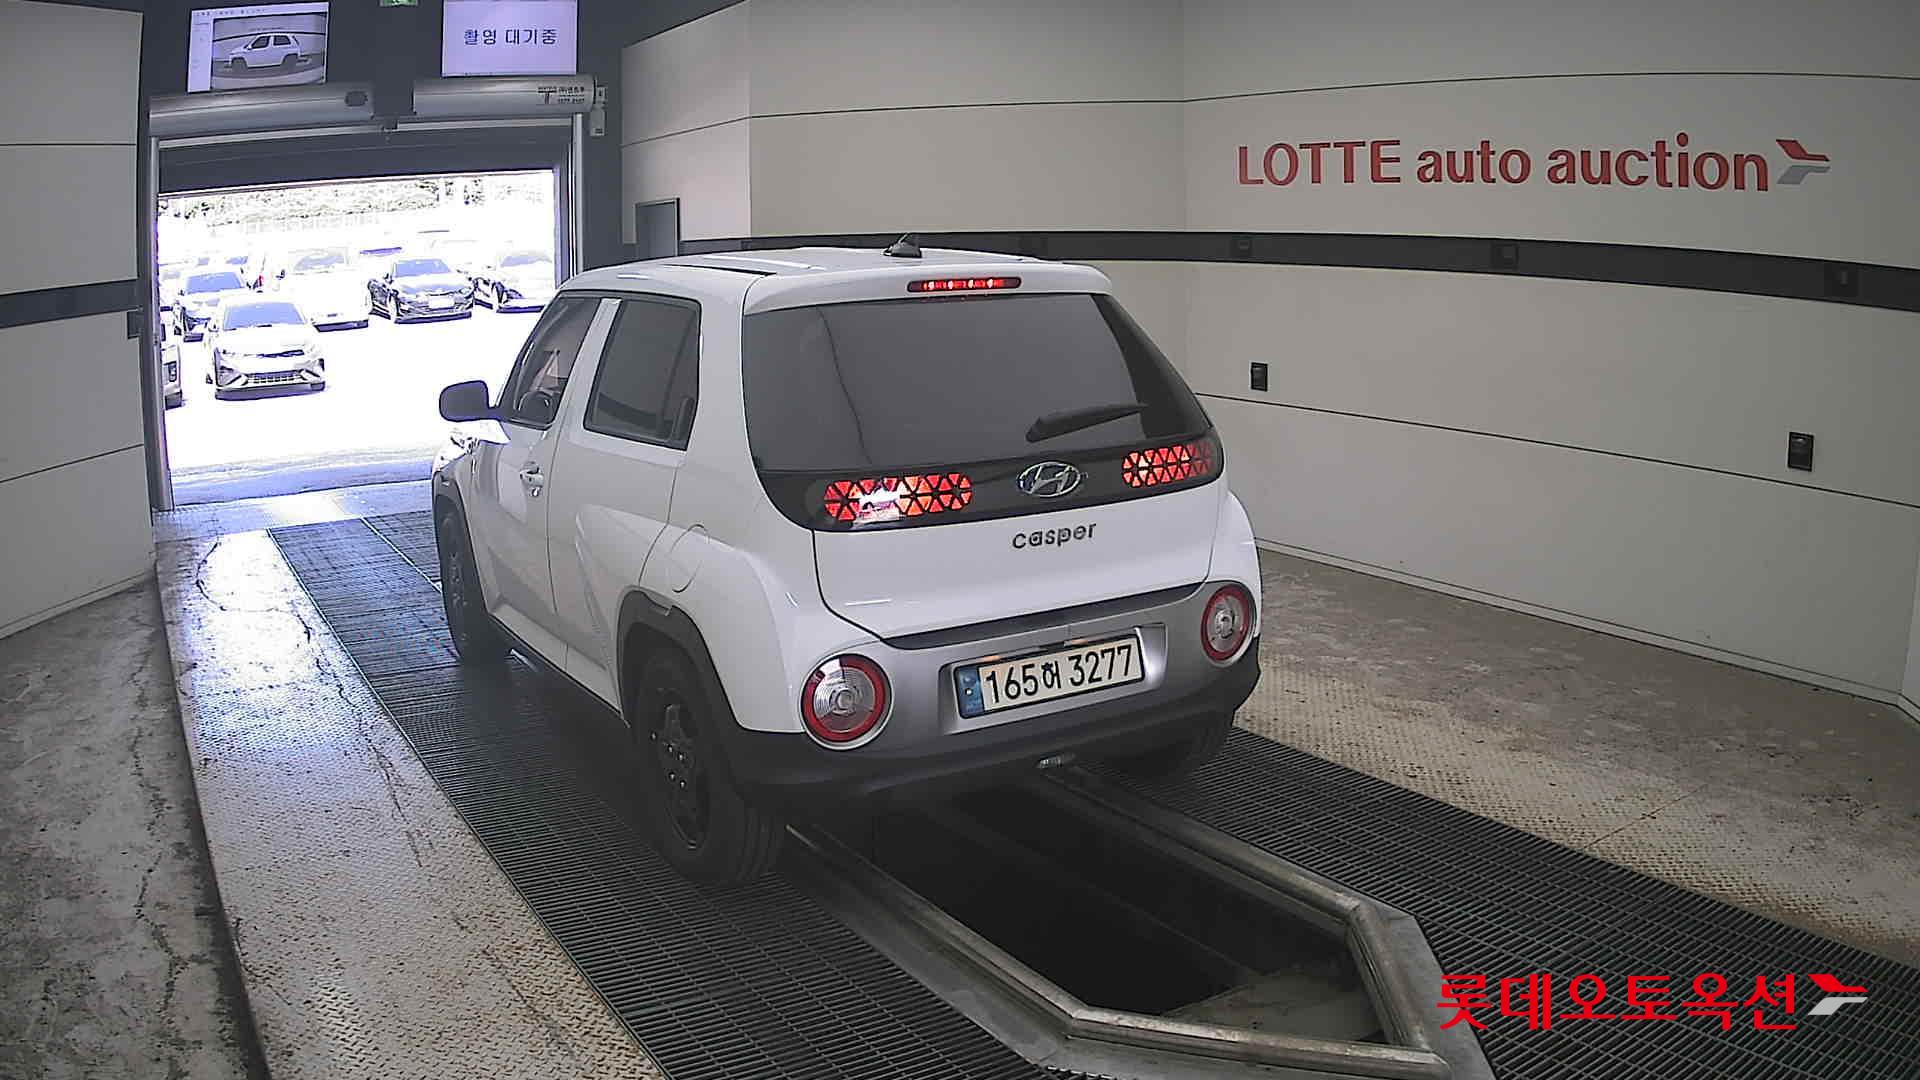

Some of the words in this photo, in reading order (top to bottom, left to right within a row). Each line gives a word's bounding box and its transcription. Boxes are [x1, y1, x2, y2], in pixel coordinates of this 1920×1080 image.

[464, 28, 497, 46] 촬영
[504, 28, 558, 46] 대기중
[1239, 140, 1401, 185] LOTTE
[1417, 140, 1531, 184] auto
[1547, 132, 1769, 192] auction
[1012, 522, 1097, 550] casper
[985, 660, 1062, 704] 165허
[1069, 644, 1133, 687] 3277
